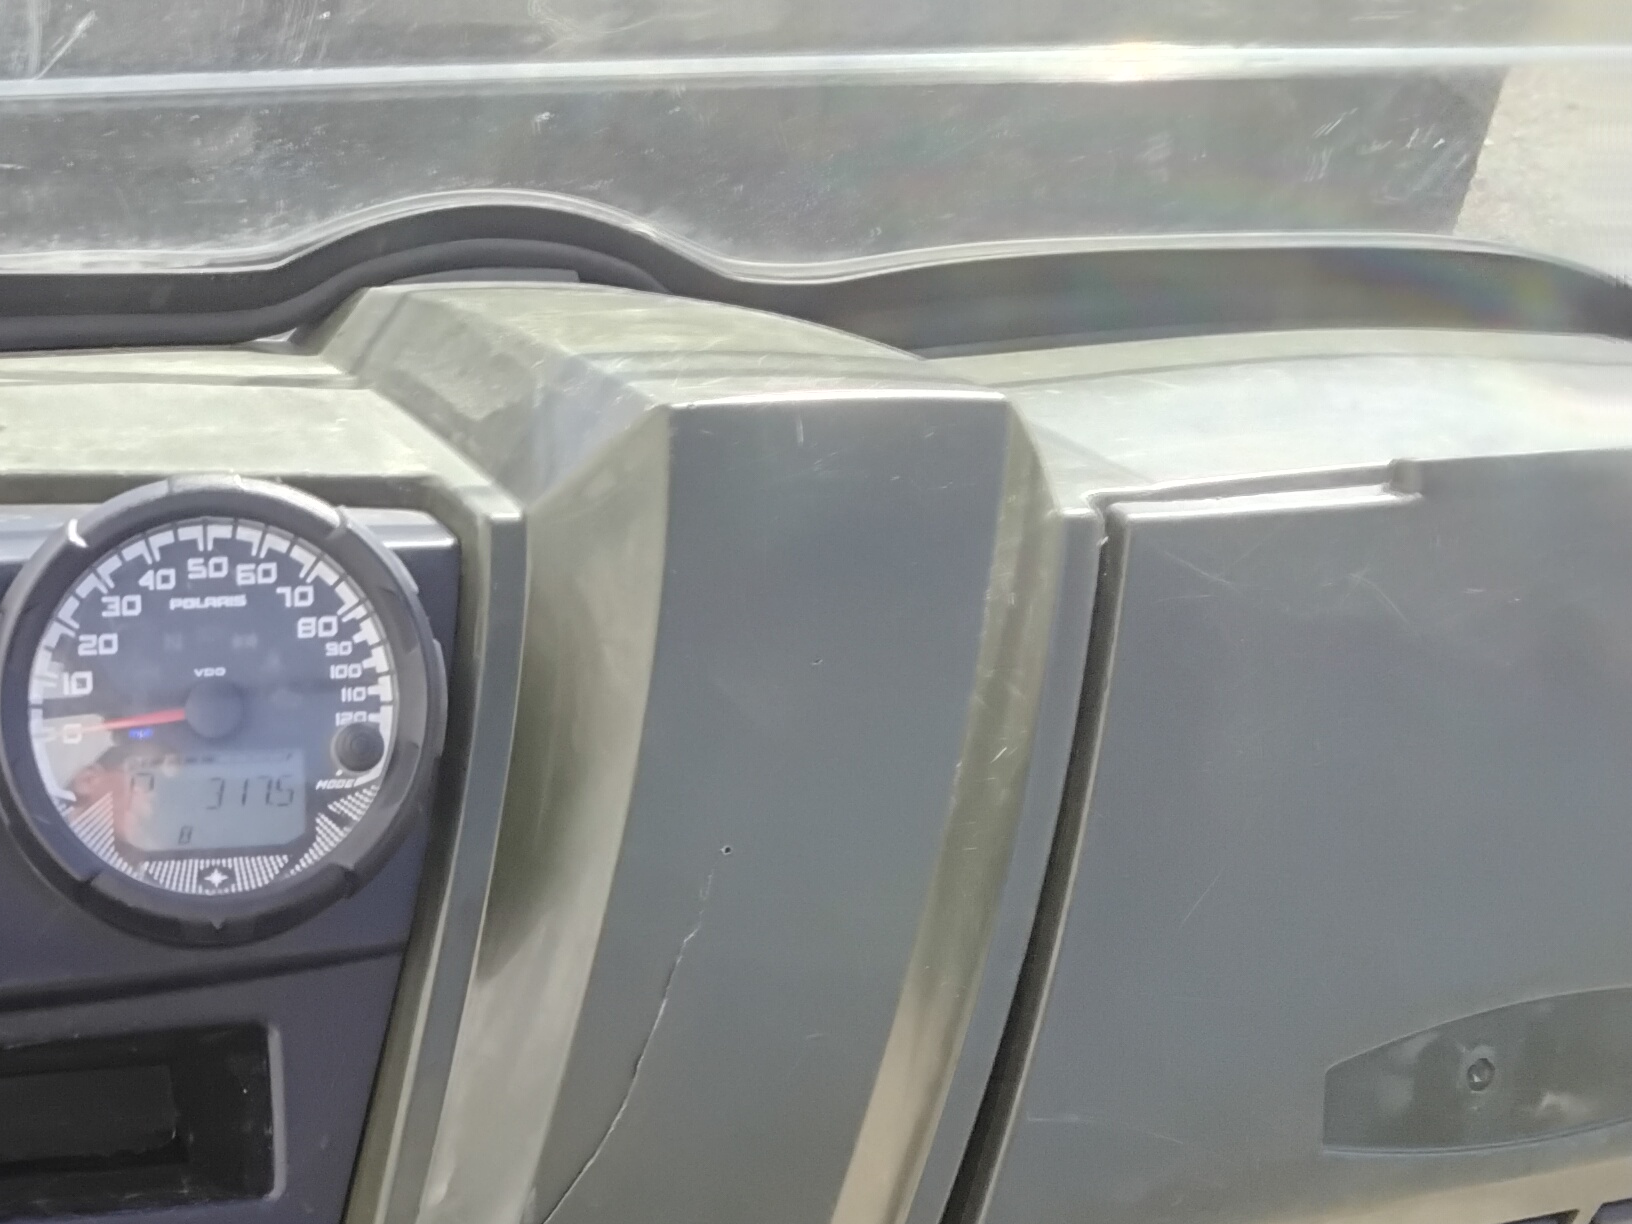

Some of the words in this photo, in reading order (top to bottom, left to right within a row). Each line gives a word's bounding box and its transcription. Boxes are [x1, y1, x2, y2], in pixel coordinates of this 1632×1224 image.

[186, 557, 229, 580] 50
[236, 562, 278, 585] 60
[138, 569, 177, 591] 40
[101, 595, 142, 618] 30
[169, 594, 247, 611] POLARIS
[276, 586, 315, 608] 70
[297, 616, 339, 639] 80
[77, 634, 119, 656] 20
[325, 641, 353, 656] 90
[194, 667, 226, 677] VDO
[330, 664, 363, 679] 100
[63, 671, 93, 695] 10
[341, 687, 366, 702] 110
[335, 712, 367, 725] 120
[63, 723, 82, 744] 0
[316, 777, 356, 791] MODE
